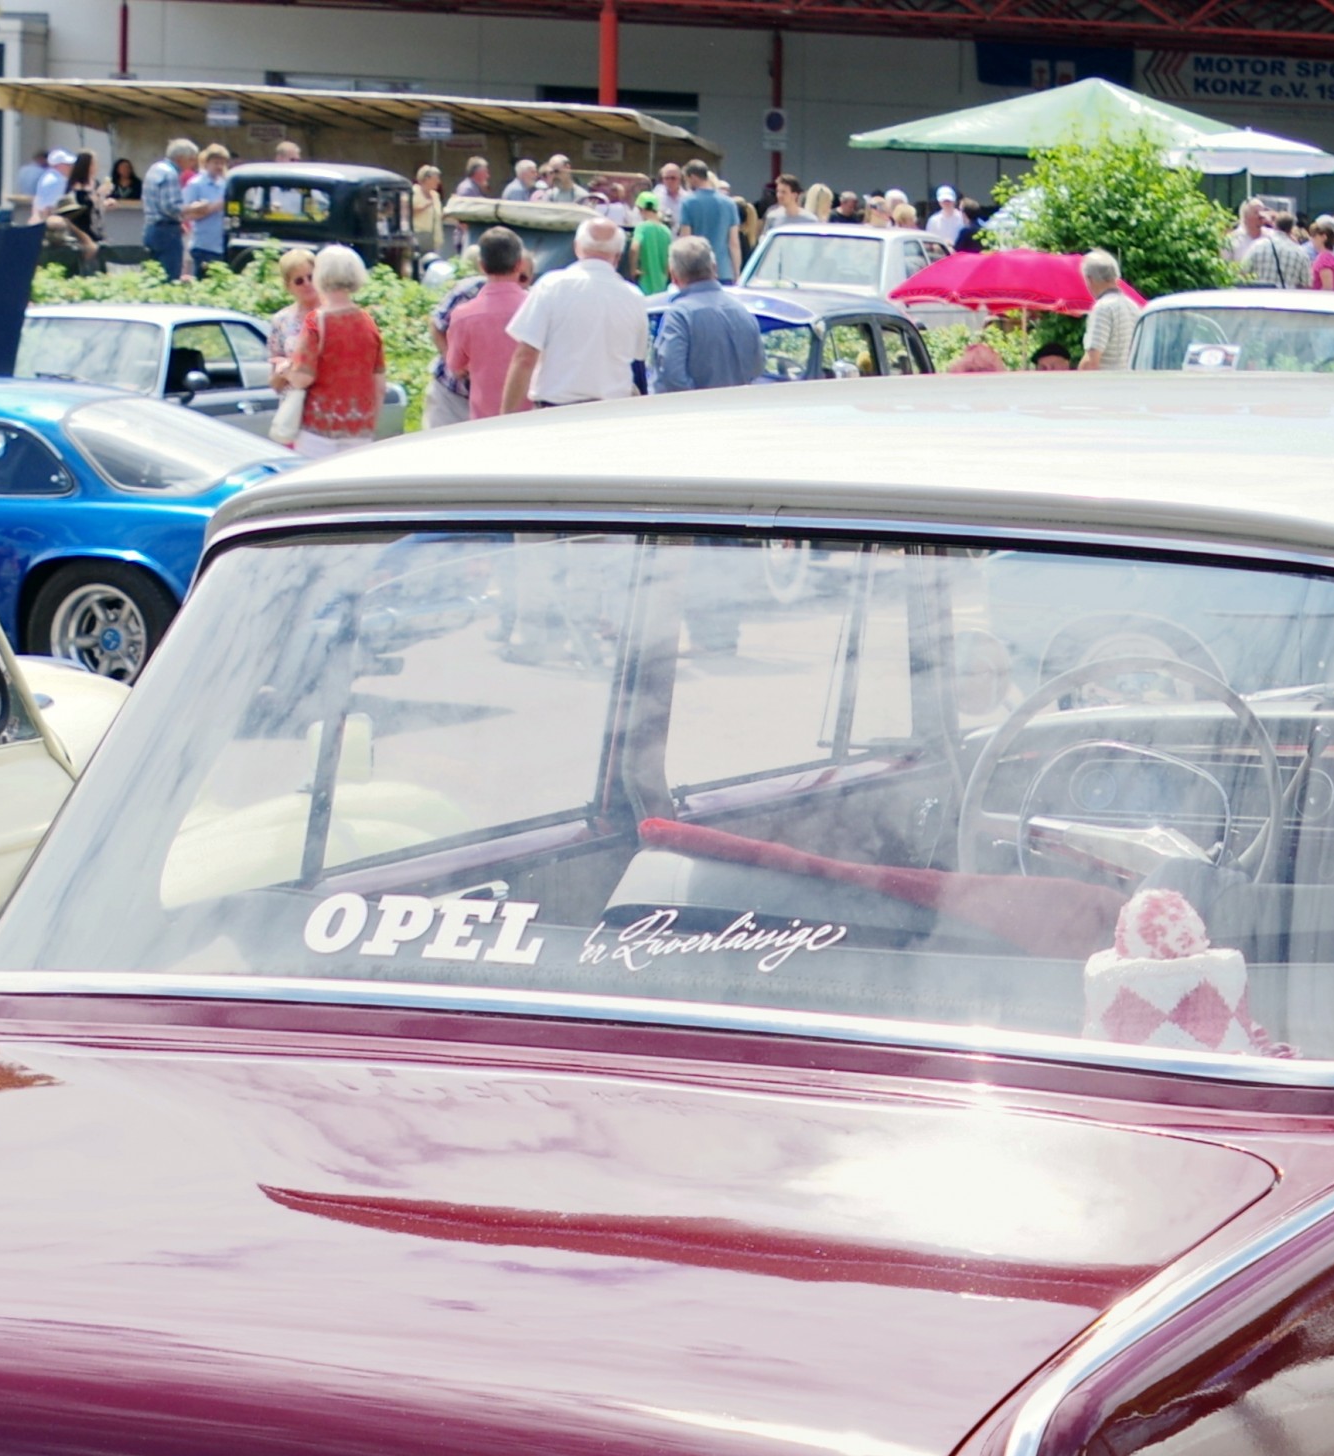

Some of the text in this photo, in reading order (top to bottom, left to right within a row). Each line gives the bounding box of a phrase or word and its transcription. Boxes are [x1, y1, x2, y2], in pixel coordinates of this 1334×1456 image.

[1193, 56, 1287, 77] MOTOR
[1193, 77, 1262, 97] KONZ
[1270, 82, 1309, 100] e.V.
[303, 892, 545, 966] OPEL
